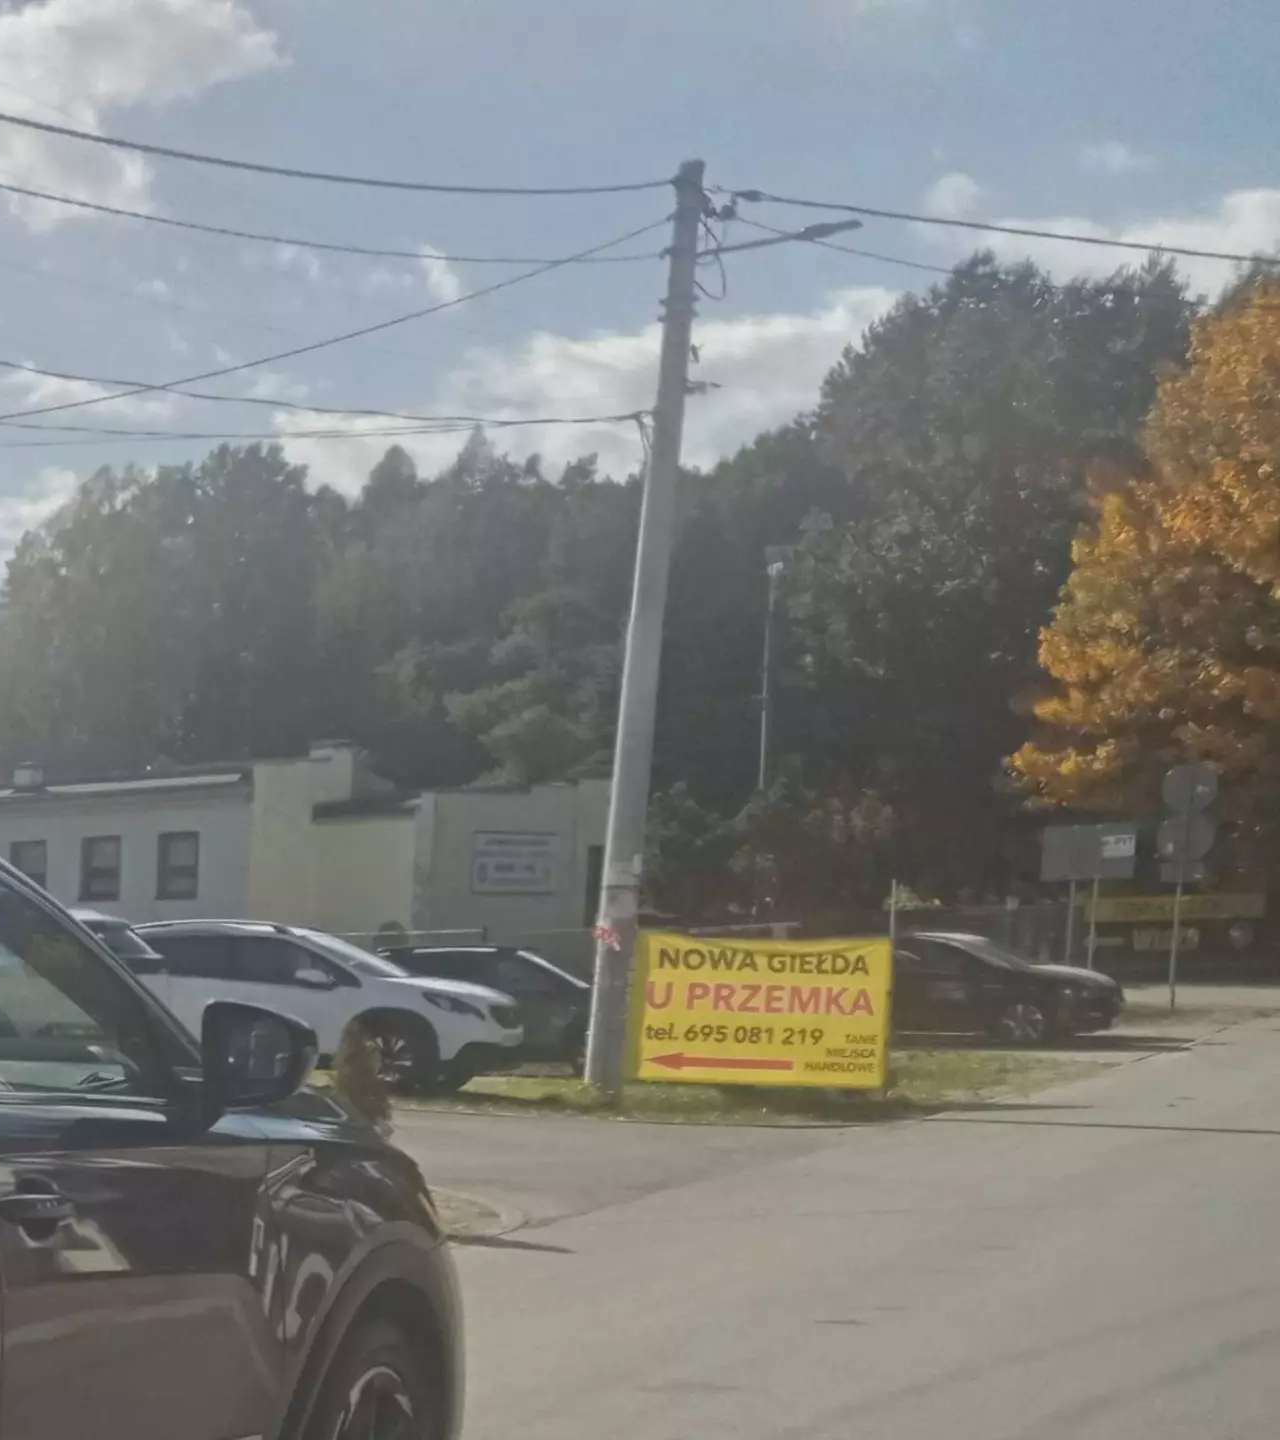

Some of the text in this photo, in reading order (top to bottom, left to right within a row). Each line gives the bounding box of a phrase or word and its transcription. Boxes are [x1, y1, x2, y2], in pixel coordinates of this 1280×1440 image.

[658, 948, 870, 976] NOWA GIEŁDA
[644, 980, 874, 1016] U PRZEMKA
[645, 1023, 824, 1046] tel. 695 081 219
